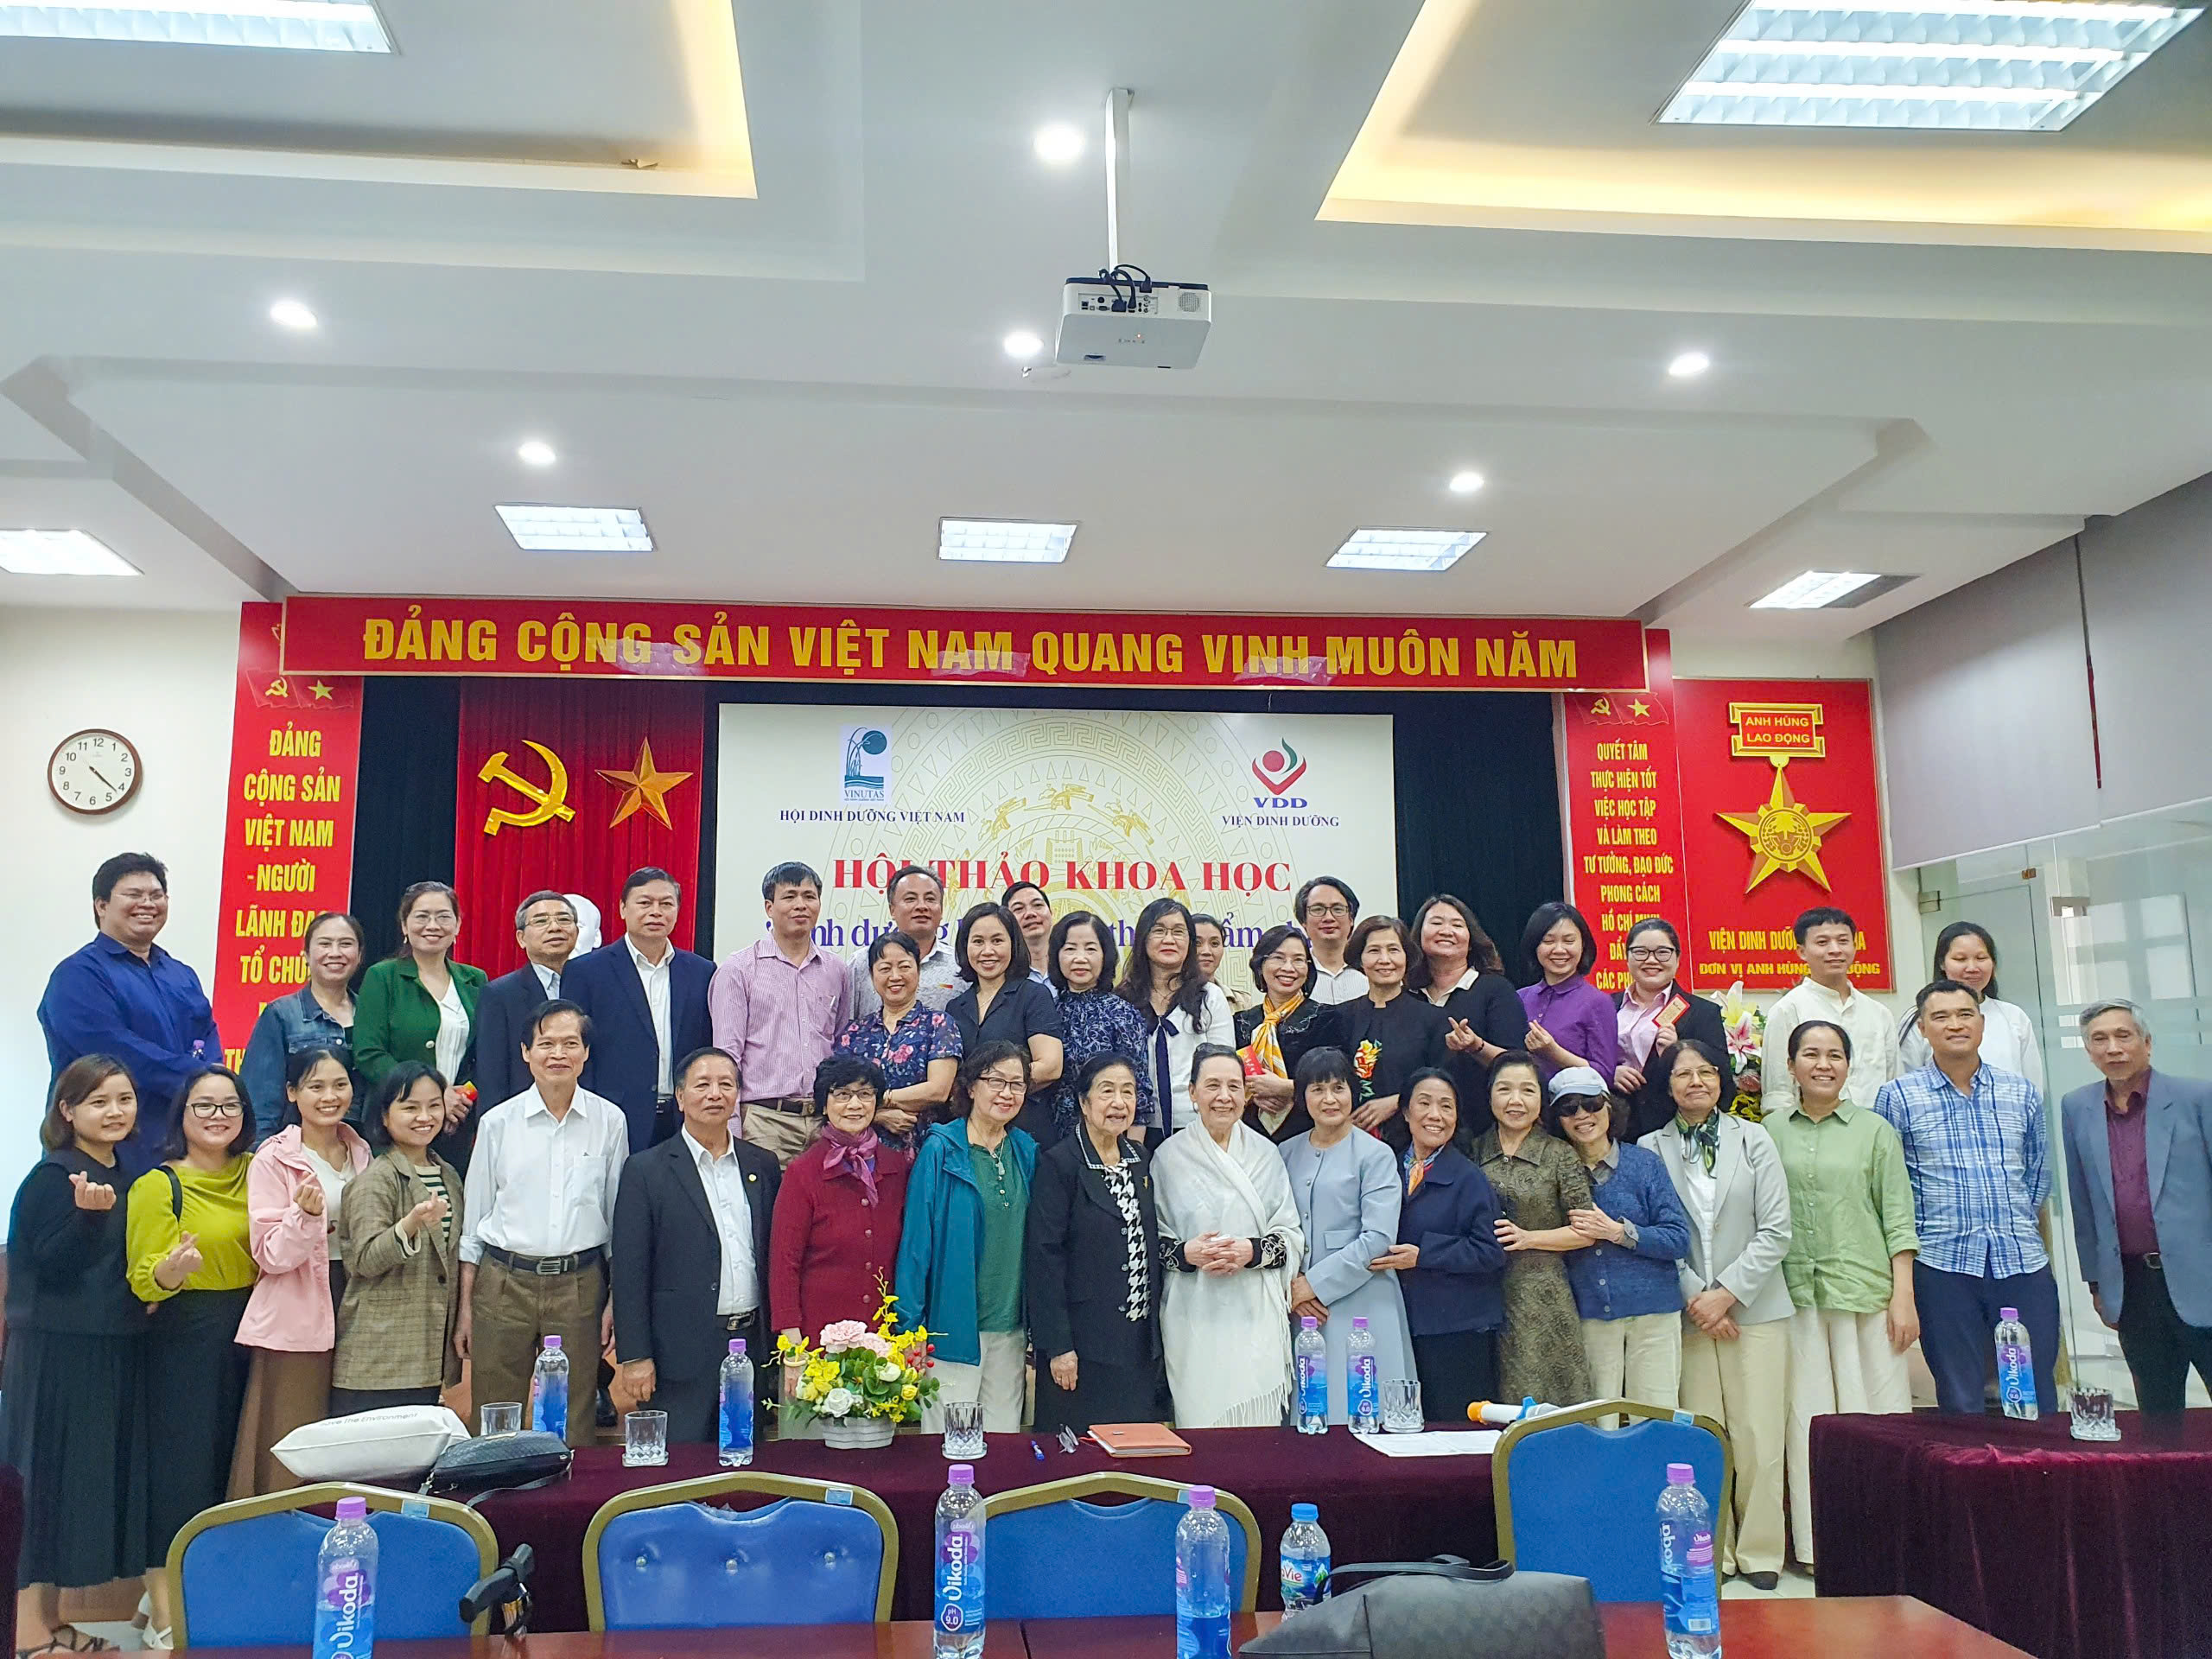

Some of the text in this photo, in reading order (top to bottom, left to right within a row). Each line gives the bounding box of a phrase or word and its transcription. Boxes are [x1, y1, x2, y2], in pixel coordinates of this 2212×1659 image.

[363, 604, 1577, 678] ĐẢNG CỘNG SẢN VIỆT NAM QUANG VINH MUÔN NĂM
[1745, 715, 1809, 727] ANH HÙNG
[78, 741, 87, 751] 11
[93, 738, 104, 747] 12
[112, 742, 116, 751] 1
[270, 721, 321, 757] ĐẢNG
[1746, 733, 1771, 742] LAO
[66, 752, 76, 761] 10
[1597, 737, 1648, 761] QUYẾT TÂM
[59, 766, 66, 775] 9
[124, 767, 131, 777] 3
[1591, 765, 1657, 792] THỰC HIỆN TỐT
[62, 781, 69, 790] 8
[74, 791, 81, 800] 7
[118, 782, 124, 791] 4
[244, 766, 340, 807] CỘNG SẢN
[89, 796, 96, 805] 6
[105, 792, 112, 802] 5
[1253, 798, 1307, 809] VDD
[780, 809, 964, 824] HỘI DINH DƯỠNG VIỆT NAM
[1594, 796, 1656, 820] VIỆC HỌC TẬP
[1222, 814, 1339, 828] VIỆN DINH DƯỠNG
[245, 813, 334, 852] VIỆT NAM
[1597, 823, 1657, 845] VÀ LÀM THEO
[833, 851, 1291, 897] HỘ THẢO KHOA HỌC
[1584, 855, 1596, 874] TƯ
[1633, 856, 1652, 877] ĐẠO
[1655, 851, 1673, 874] ĐỨC
[1600, 881, 1660, 902] PHONG CÁCH
[236, 905, 286, 938] LÃNH
[1618, 910, 1631, 931] CHÍ
[1708, 927, 1735, 953] VIỆN
[1738, 931, 1766, 950] DINH
[240, 944, 311, 983] TỔ CHỨ
[1700, 962, 1726, 975] ĐƠN
[1730, 963, 1743, 978] VỊ
[1746, 963, 1774, 975] ANH
[1777, 962, 1811, 976] HÙNG
[1596, 968, 1615, 989] CÁC
[1358, 1358, 1371, 1398] Vikoda
[943, 1534, 963, 1601] Vikoda
[329, 1573, 359, 1649] Vikoda
[945, 1615, 959, 1625] 9.0
